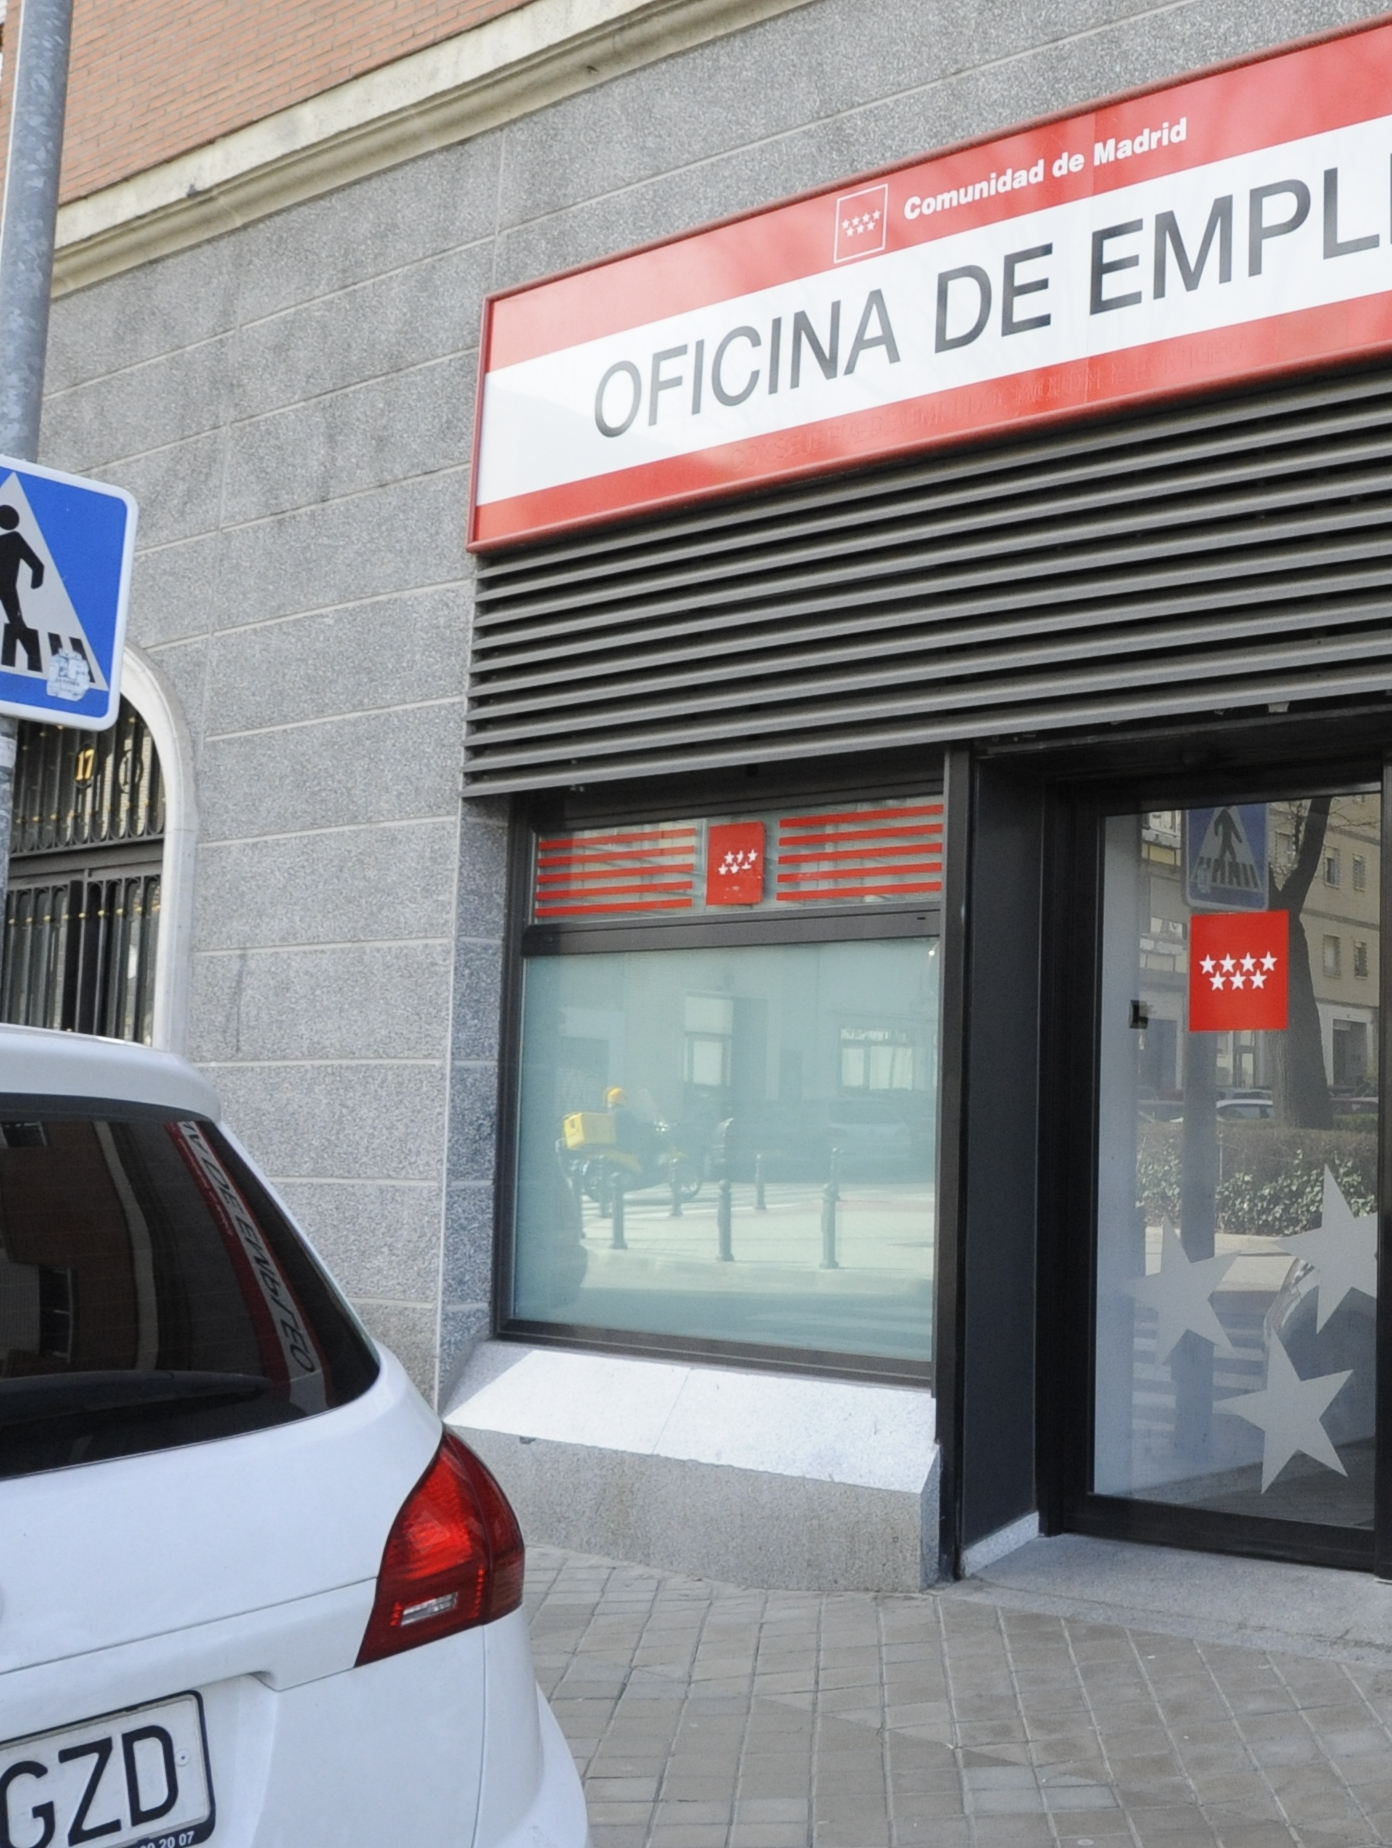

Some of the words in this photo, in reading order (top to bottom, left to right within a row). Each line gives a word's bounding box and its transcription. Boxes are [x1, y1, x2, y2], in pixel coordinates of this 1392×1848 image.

[903, 159, 1045, 220] Comunidad
[1052, 151, 1085, 178] de
[1093, 116, 1188, 166] Madrid
[594, 288, 901, 438] OFICINA
[934, 242, 1053, 354] DE
[75, 748, 95, 781] 17
[0, 1724, 180, 1848] GZD
[179, 1830, 195, 1846] 07
